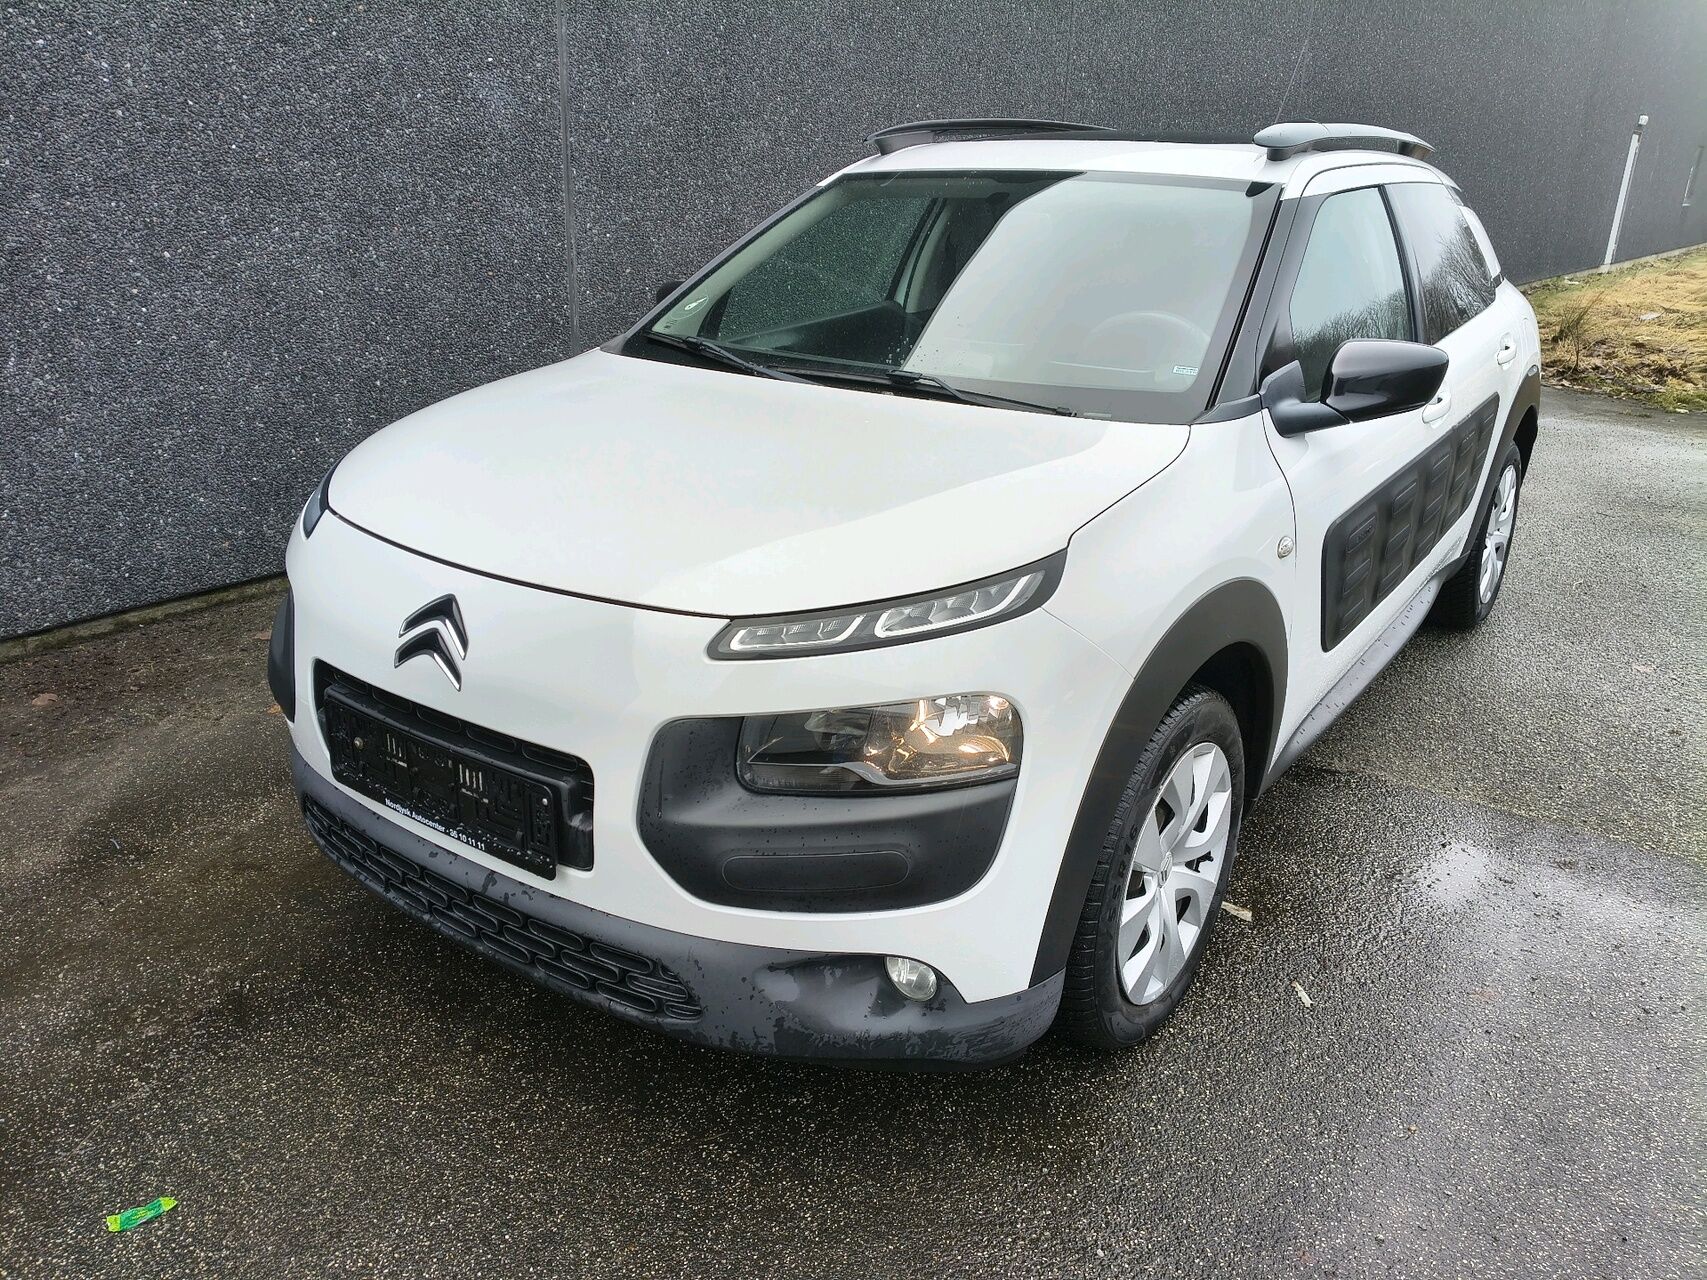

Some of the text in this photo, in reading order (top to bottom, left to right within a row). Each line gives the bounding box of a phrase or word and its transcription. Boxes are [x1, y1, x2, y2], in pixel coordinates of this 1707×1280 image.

[385, 798, 411, 817] Nordjysk
[412, 811, 445, 832] Autocenter
[459, 833, 467, 843] 10
[468, 837, 476, 847] 11
[477, 841, 485, 851] 11
